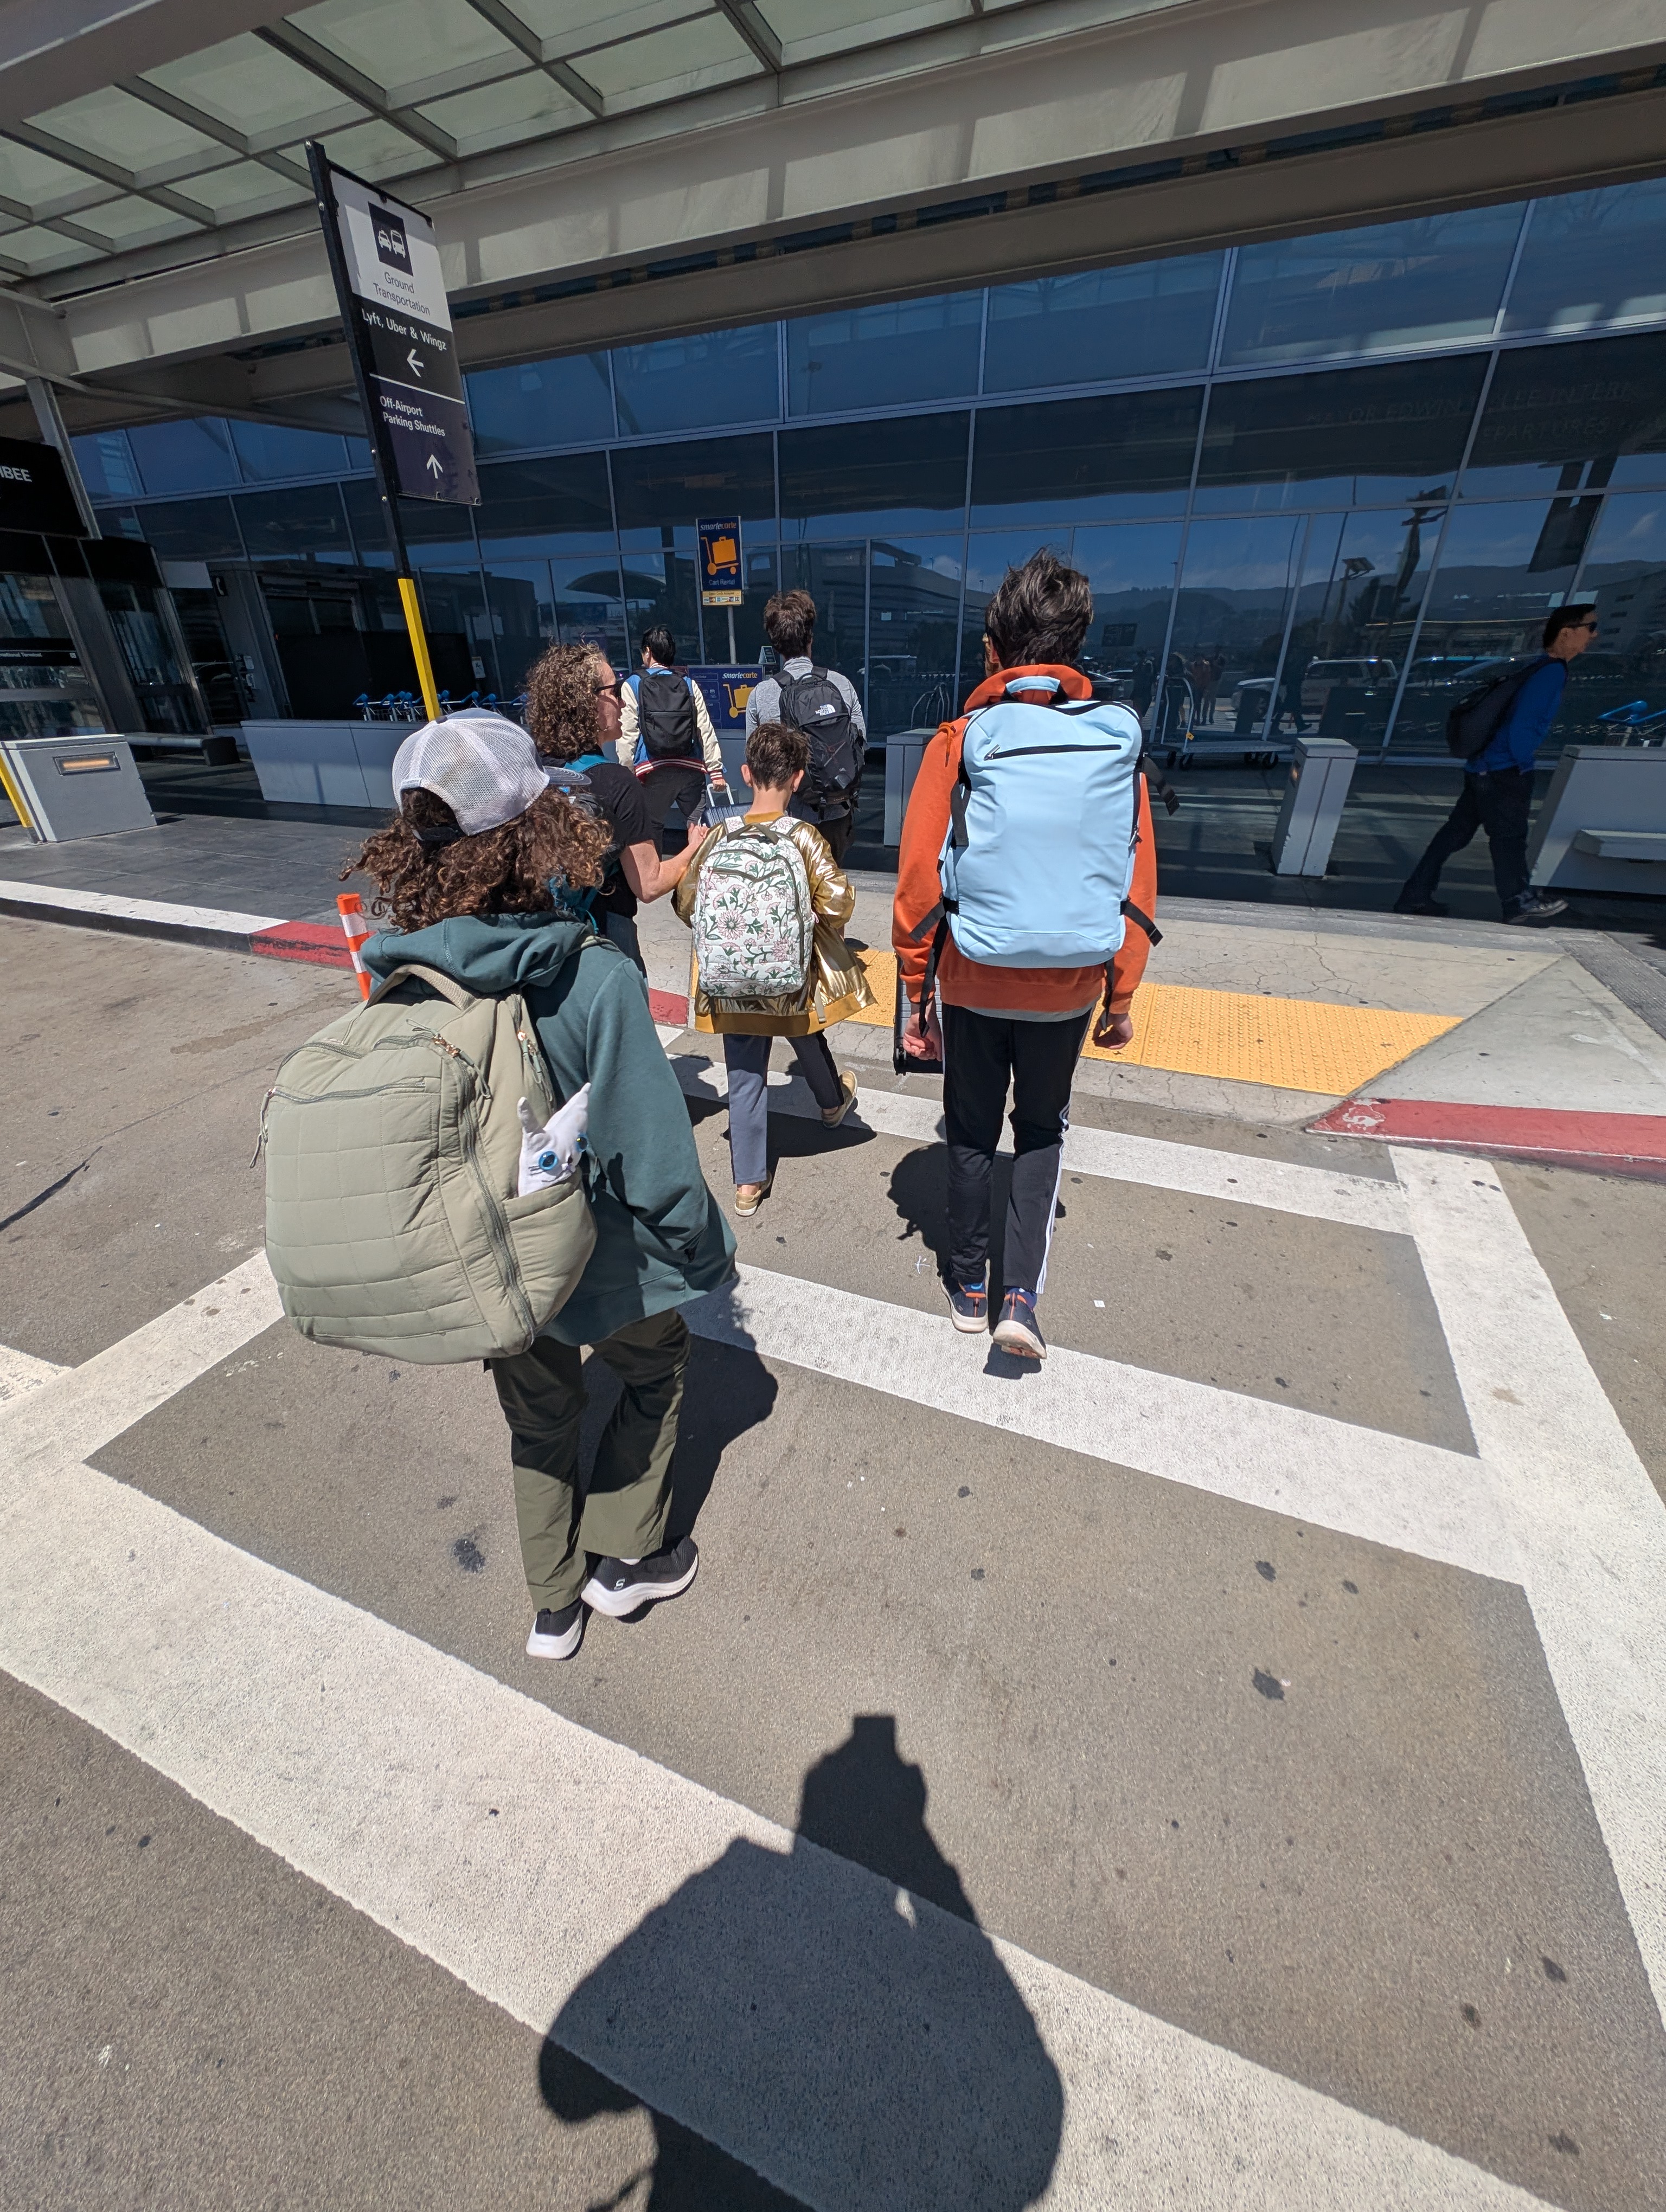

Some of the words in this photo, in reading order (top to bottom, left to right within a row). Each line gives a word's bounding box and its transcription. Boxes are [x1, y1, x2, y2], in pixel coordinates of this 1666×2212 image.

[384, 272, 414, 293] Ground
[373, 282, 430, 316] Transportation
[362, 308, 383, 327] Lyft,
[386, 317, 407, 335] Uber
[409, 326, 418, 340] &
[420, 330, 446, 351] Wingz
[380, 396, 423, 417] Off-Airport
[383, 411, 413, 430] Parking
[414, 420, 445, 437] Shuttles
